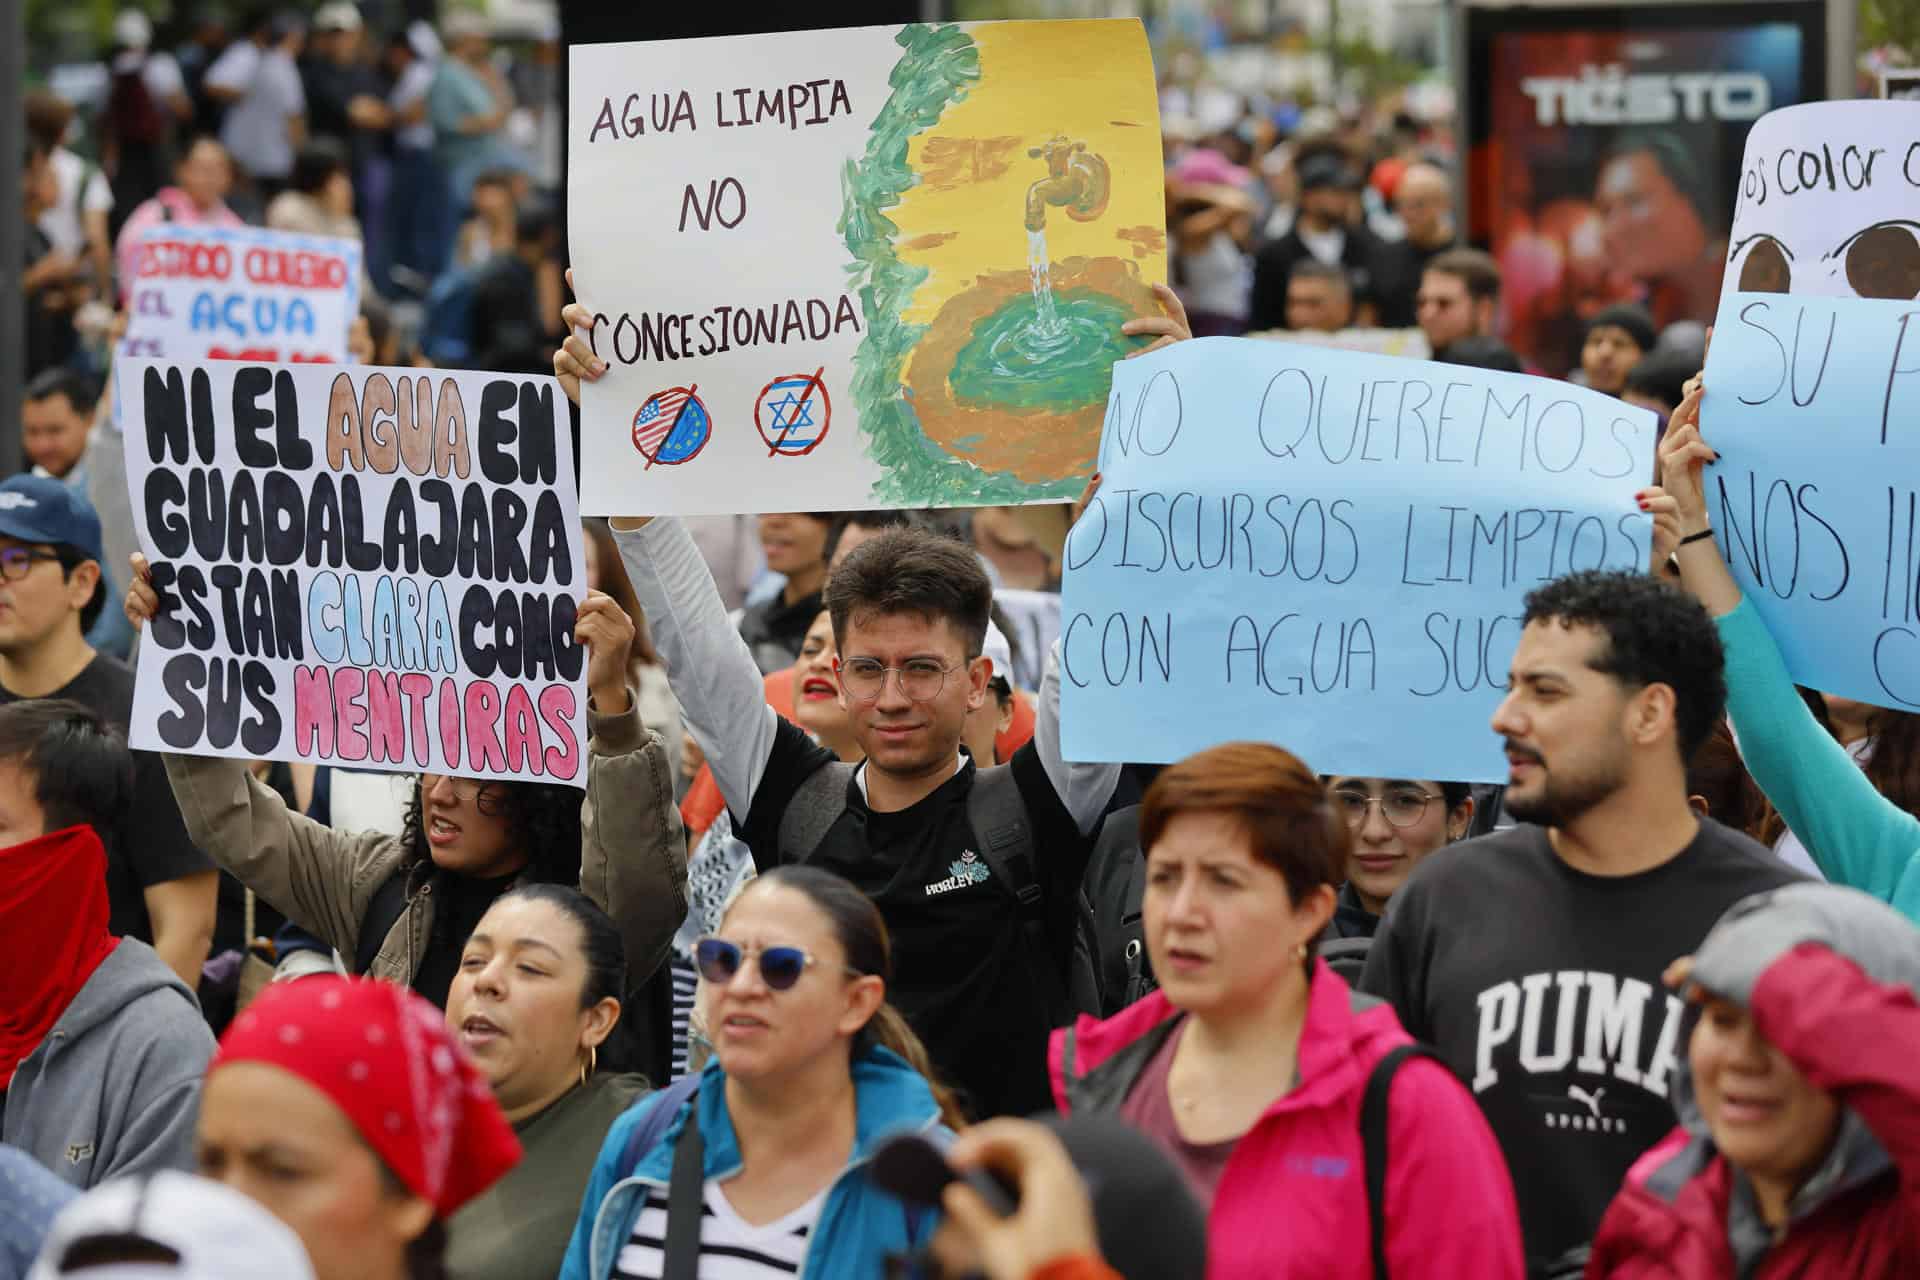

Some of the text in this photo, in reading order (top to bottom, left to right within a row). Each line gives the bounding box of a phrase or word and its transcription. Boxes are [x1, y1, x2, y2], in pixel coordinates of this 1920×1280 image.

[590, 78, 852, 143] AGUA LIMPIA
[678, 176, 747, 233] NO
[190, 291, 315, 338] AGUA
[590, 294, 861, 366] CONCESIONADA
[1738, 302, 1836, 407] SU
[143, 365, 556, 486] NI EL AGUA EN
[1100, 367, 1639, 479] NO QUEREMOS
[143, 467, 573, 587] GUADALAJARA
[1067, 488, 1644, 590] DISCURSOS LIMPIOS
[1718, 471, 1850, 601] NOS
[149, 561, 584, 682] ESTAN CLARA COMO
[1063, 611, 1172, 688] CON
[1226, 613, 1376, 696] AGUA
[1409, 612, 1524, 697] SUC
[157, 653, 580, 781] SUS MENTIRAS
